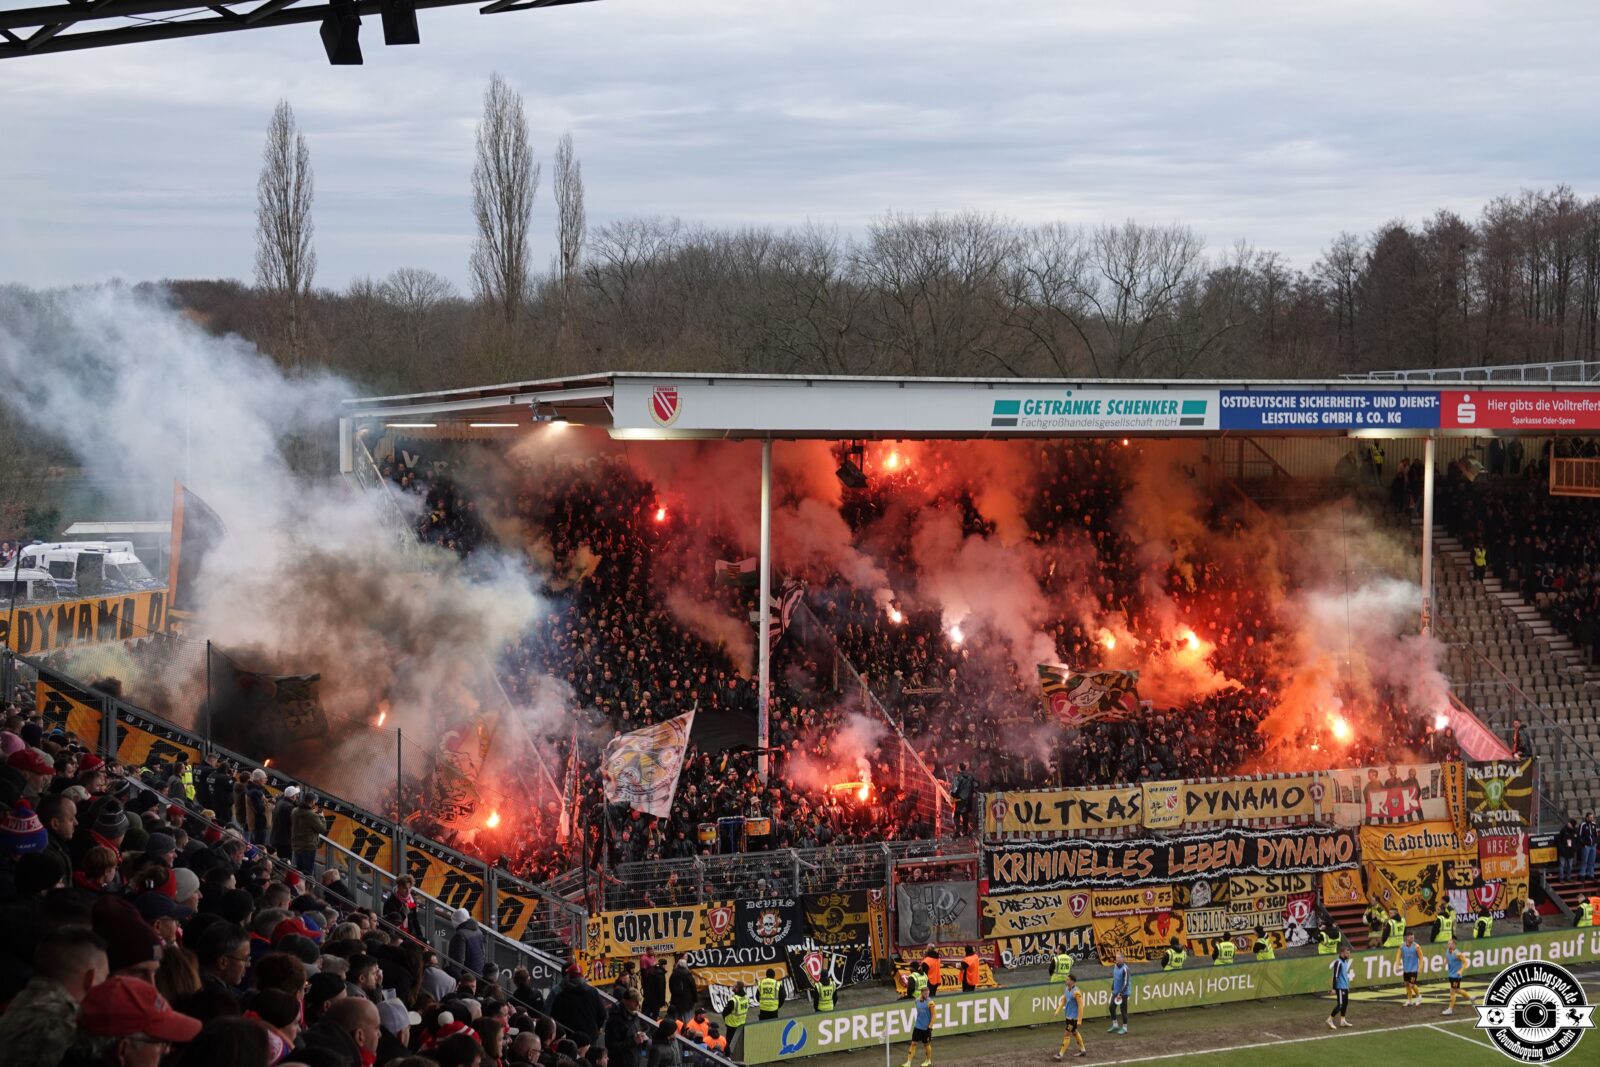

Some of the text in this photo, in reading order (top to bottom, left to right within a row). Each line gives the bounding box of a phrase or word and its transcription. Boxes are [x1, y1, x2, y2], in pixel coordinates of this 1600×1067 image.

[1023, 390, 1179, 416] GETRÄNKE SCHENKER
[1221, 396, 1440, 408] OSTDEUTSCHE SICHERHEITS- UND DIENST-
[1487, 399, 1507, 411] Hier
[1509, 399, 1533, 413] gibts
[1536, 399, 1550, 411] die
[1021, 417, 1178, 429] Fachgroßhandelsgesellschaft mbH
[1261, 412, 1402, 424] LEISTUNGS GMBH & CO. KG
[1512, 416, 1576, 425] Sparkasse Oder-Spree
[1013, 793, 1141, 825] ULTRAS
[1185, 786, 1305, 815] DYNAMO
[1383, 829, 1460, 853] Radeburg
[992, 834, 1354, 884] KRIMINELLES LEBEN DYNAMO
[745, 898, 796, 910] DEVILS
[996, 895, 1063, 915] DRESDEN
[1094, 894, 1140, 907] BRIGADE
[1157, 891, 1172, 903] 53
[1266, 896, 1286, 908] SGD
[613, 910, 695, 943] GÖRLITZ
[1548, 937, 1586, 963] auf
[1142, 980, 1195, 1001] SAUNA
[1206, 974, 1255, 993] HOTEL
